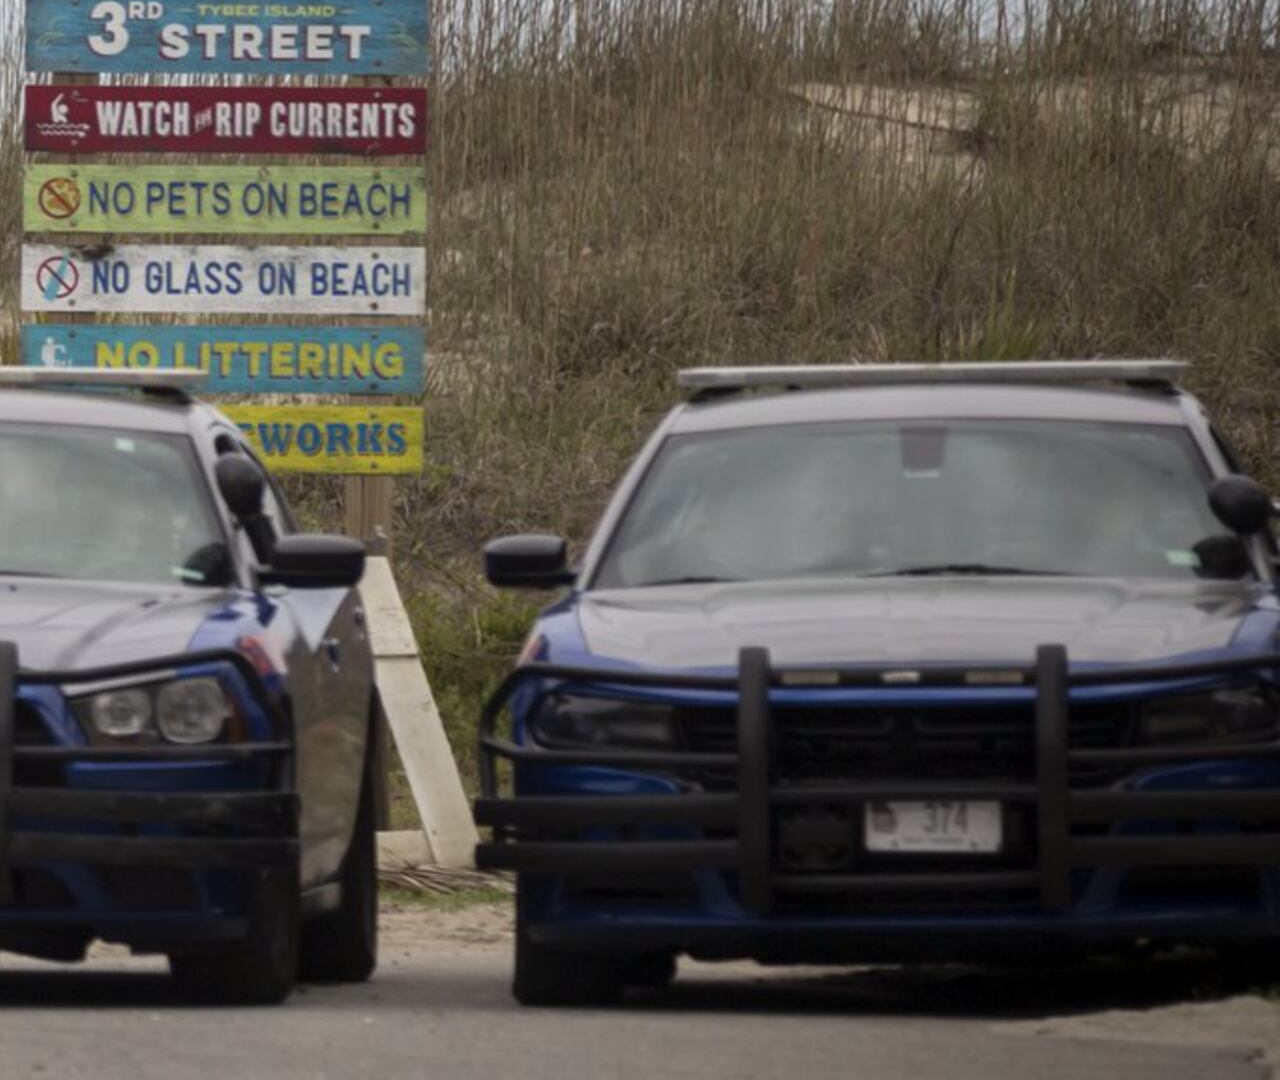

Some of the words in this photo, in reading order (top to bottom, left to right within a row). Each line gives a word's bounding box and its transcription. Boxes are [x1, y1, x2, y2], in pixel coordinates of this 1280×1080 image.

[196, 4, 260, 17] TYBEE
[264, 4, 336, 17] ISLAND
[87, 1, 164, 56] 3RD
[160, 24, 372, 60] STREET
[96, 100, 190, 136] WATCH
[215, 101, 261, 137] RIP
[270, 102, 416, 138] CURRENTS
[88, 181, 136, 214] NO
[146, 182, 231, 215] PETS
[242, 183, 287, 216] ON
[299, 183, 411, 217] BEACH
[92, 261, 130, 294] NO
[145, 261, 242, 295] GLASS
[258, 262, 296, 295] ON
[311, 263, 411, 297] BEACH
[95, 341, 159, 368] NO
[173, 342, 405, 378] LITTERING
[923, 800, 969, 834] 374
